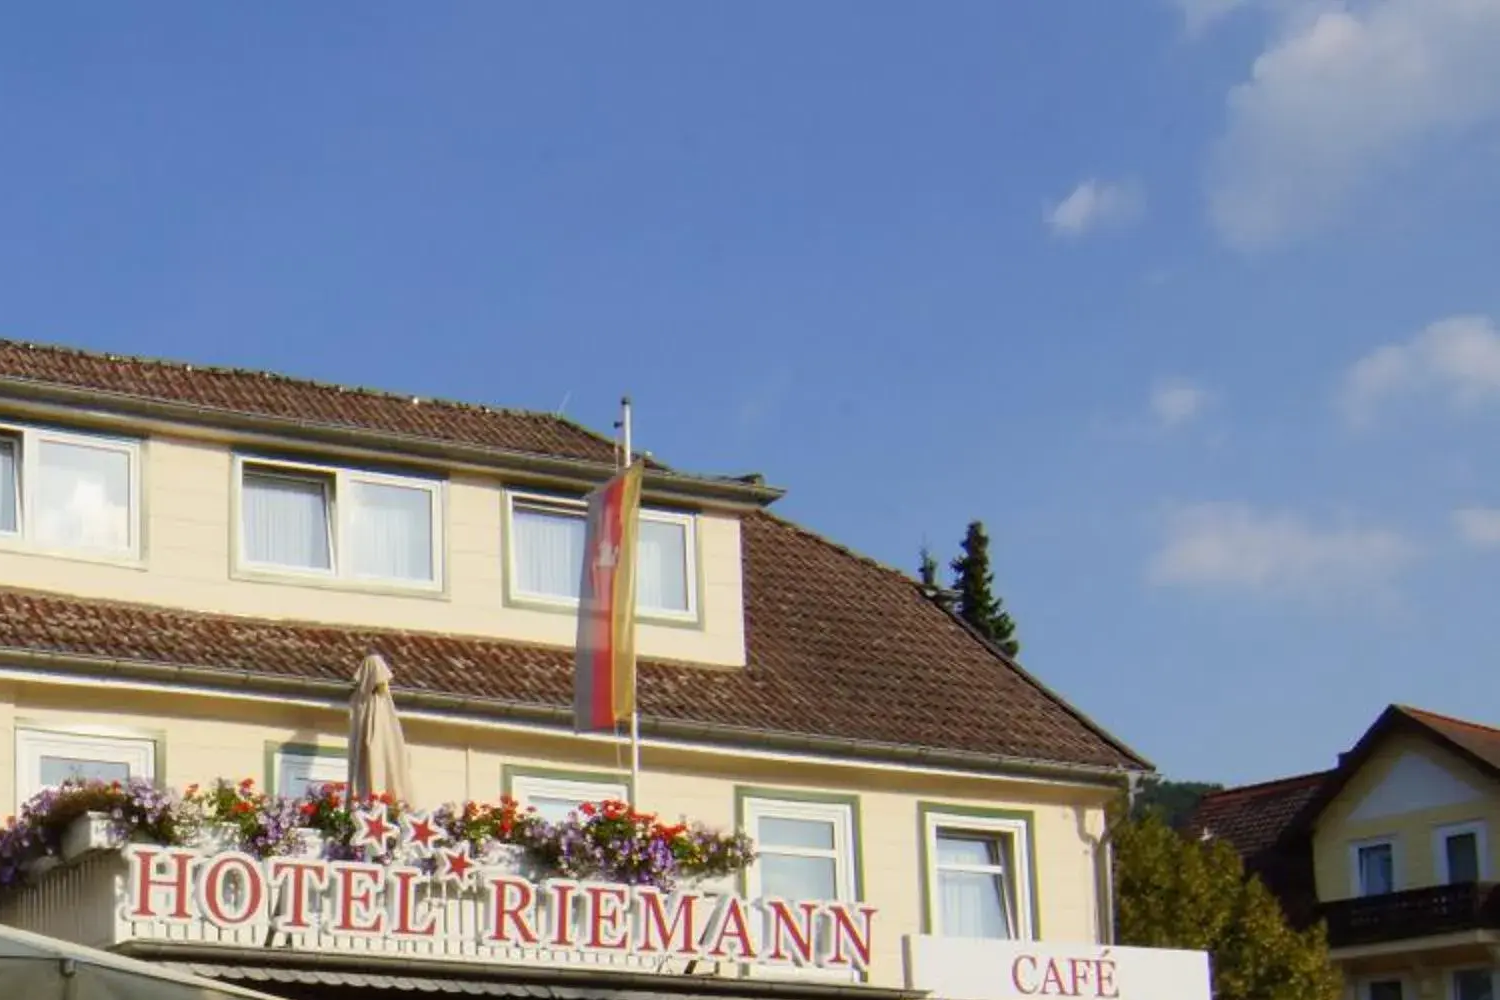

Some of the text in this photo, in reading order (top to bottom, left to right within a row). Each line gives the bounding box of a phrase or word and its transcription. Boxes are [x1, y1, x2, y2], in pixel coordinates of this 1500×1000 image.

[131, 849, 878, 966] HOTEL RIEMANN
[1011, 950, 1120, 999] CAFÉ
